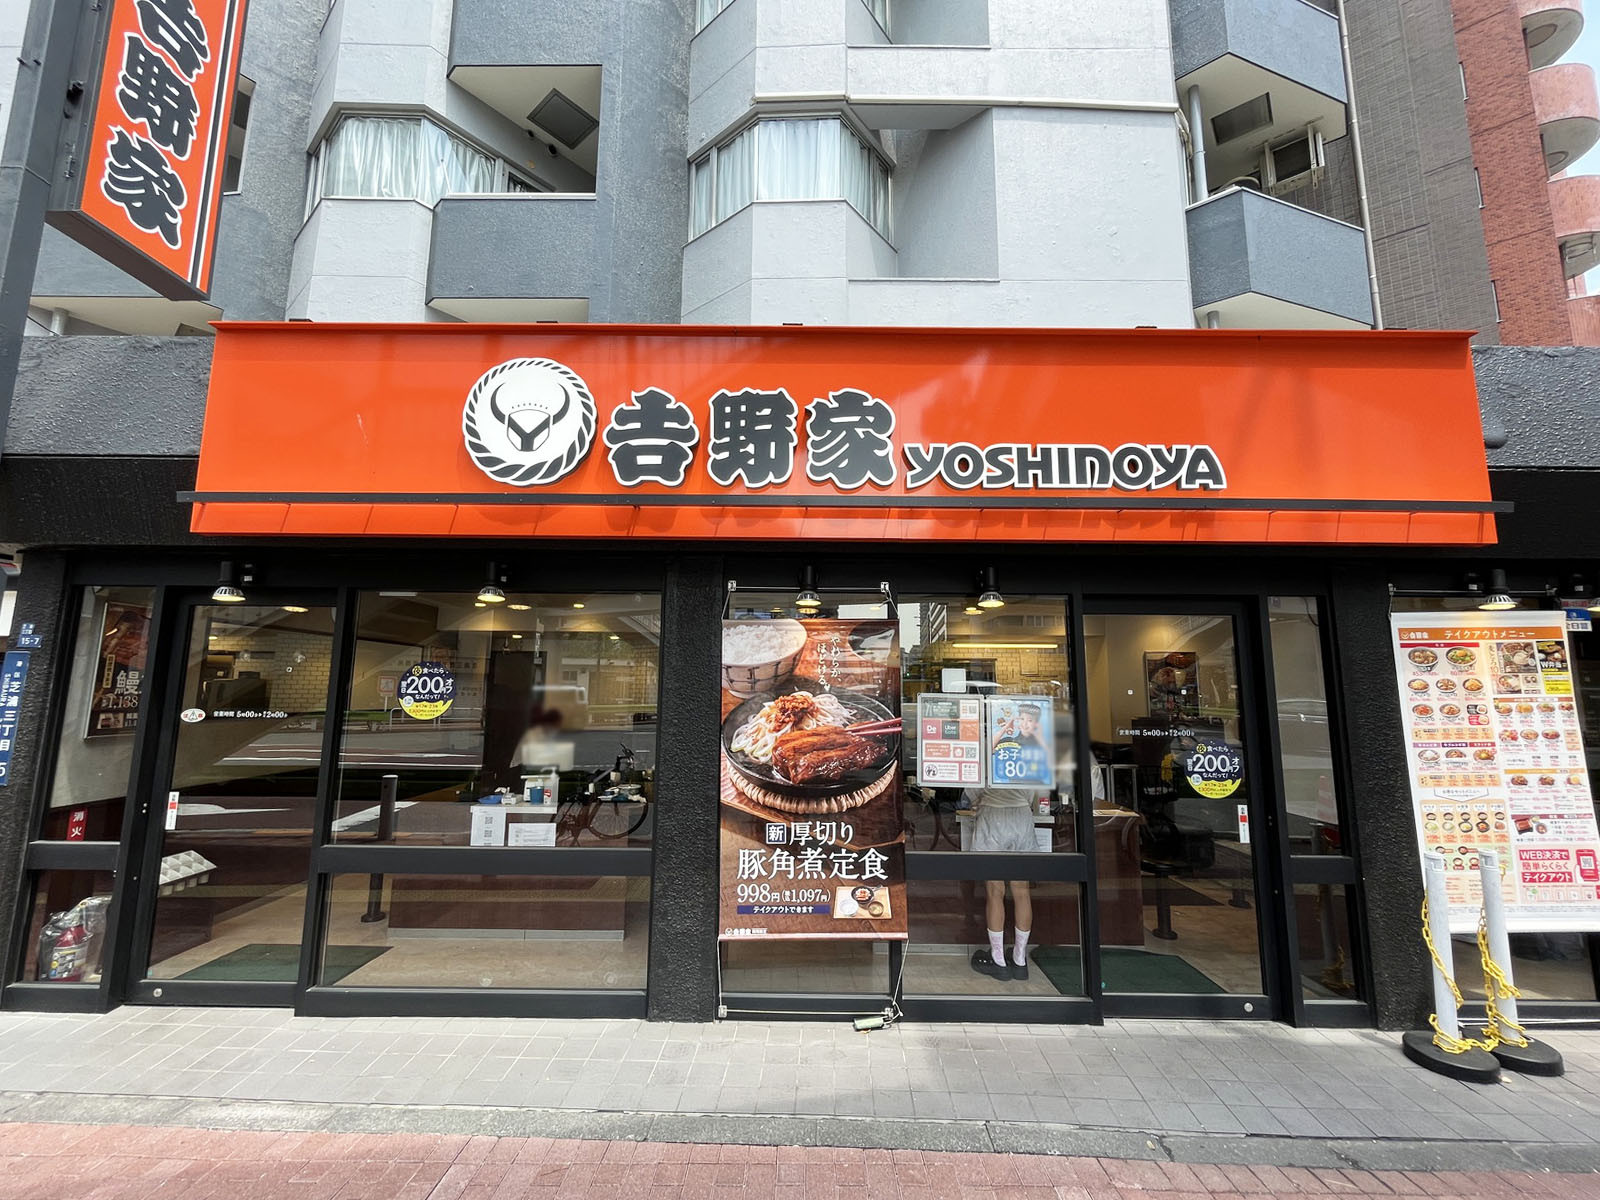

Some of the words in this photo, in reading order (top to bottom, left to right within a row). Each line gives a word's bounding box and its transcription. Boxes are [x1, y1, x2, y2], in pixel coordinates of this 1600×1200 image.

[602, 386, 898, 490] 吉野家
[902, 441, 1228, 490] YOSHINOYA
[21, 637, 40, 645] 15-7
[1444, 630, 1536, 640] テイクアウトメニュー
[70, 810, 84, 838] 消火
[789, 821, 854, 846] 厚切り
[736, 847, 889, 880] 豚角煮定食
[1523, 873, 1571, 882] テイクアウト
[753, 905, 814, 914] テイクアウトできます
